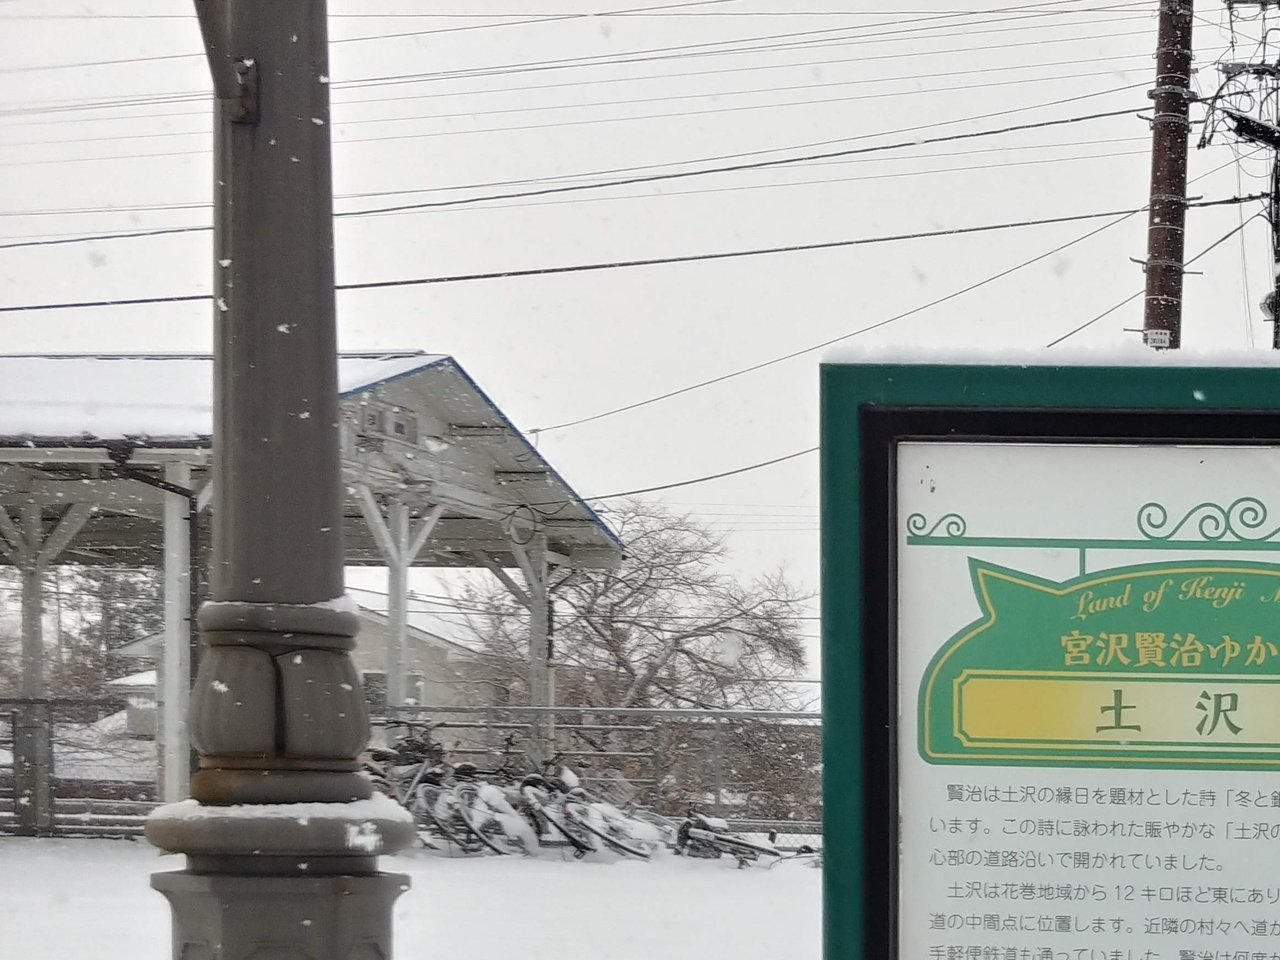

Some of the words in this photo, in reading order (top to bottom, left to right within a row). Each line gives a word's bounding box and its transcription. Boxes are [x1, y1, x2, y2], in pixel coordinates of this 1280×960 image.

[1069, 583, 1132, 621] Land
[1142, 578, 1173, 613] of
[1178, 575, 1246, 609] Kenji
[929, 848, 1224, 872] 心部の道路沿いで開かれていました。
